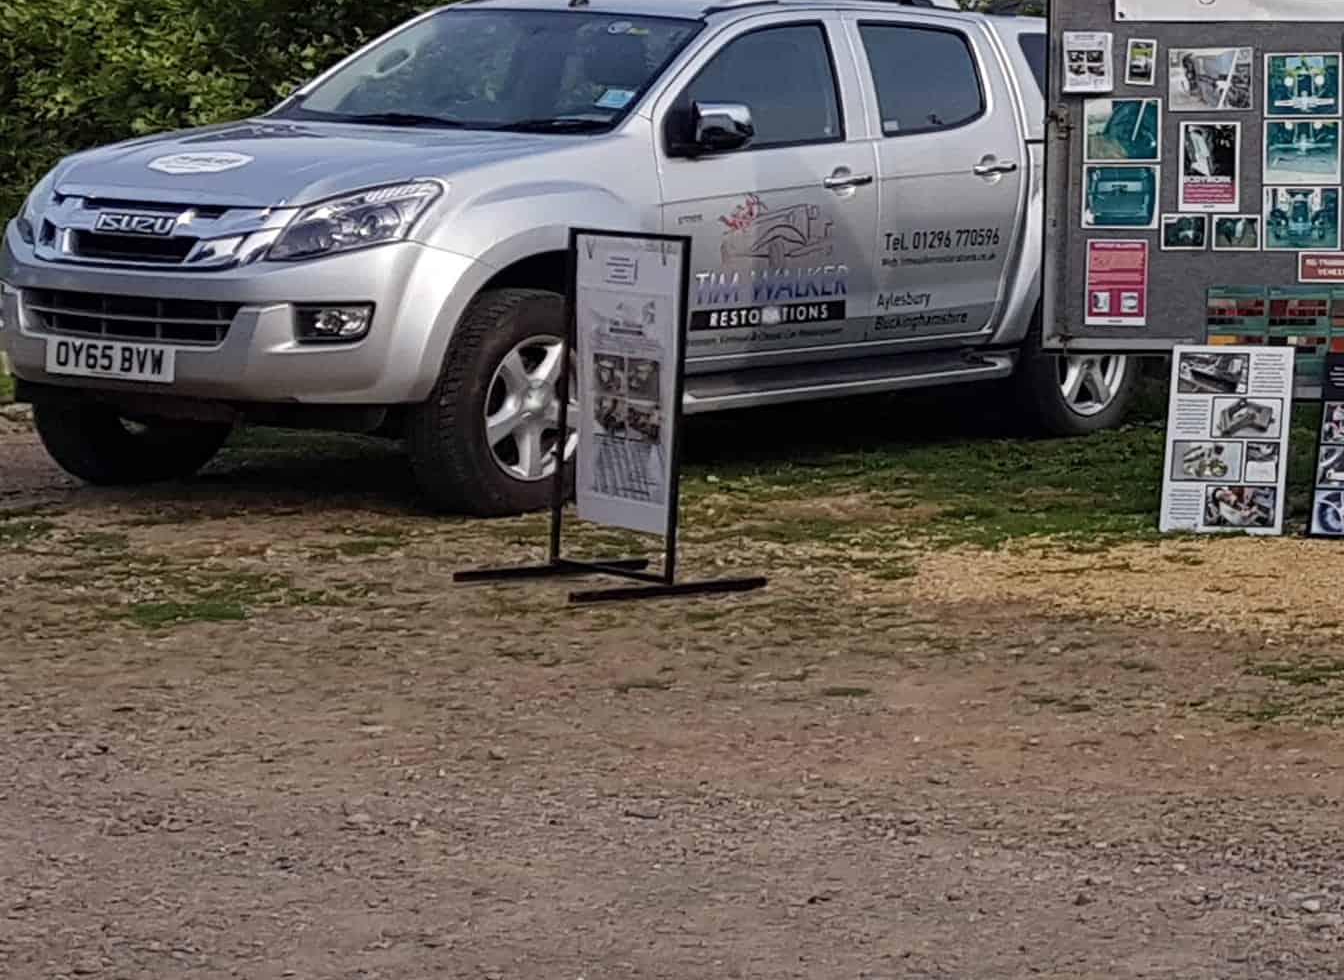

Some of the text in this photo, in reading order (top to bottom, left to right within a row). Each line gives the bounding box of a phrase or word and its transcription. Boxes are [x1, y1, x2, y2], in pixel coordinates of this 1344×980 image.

[98, 214, 175, 234] ISUZU
[913, 229, 952, 250] 01296
[956, 227, 1000, 247] 770596
[696, 264, 848, 305] TIM WALKER
[877, 291, 932, 310] Aylesbury
[709, 304, 829, 328] RESTOTIONS
[874, 312, 969, 332] Buckinghamshire
[56, 340, 164, 374] OY65 BVW
